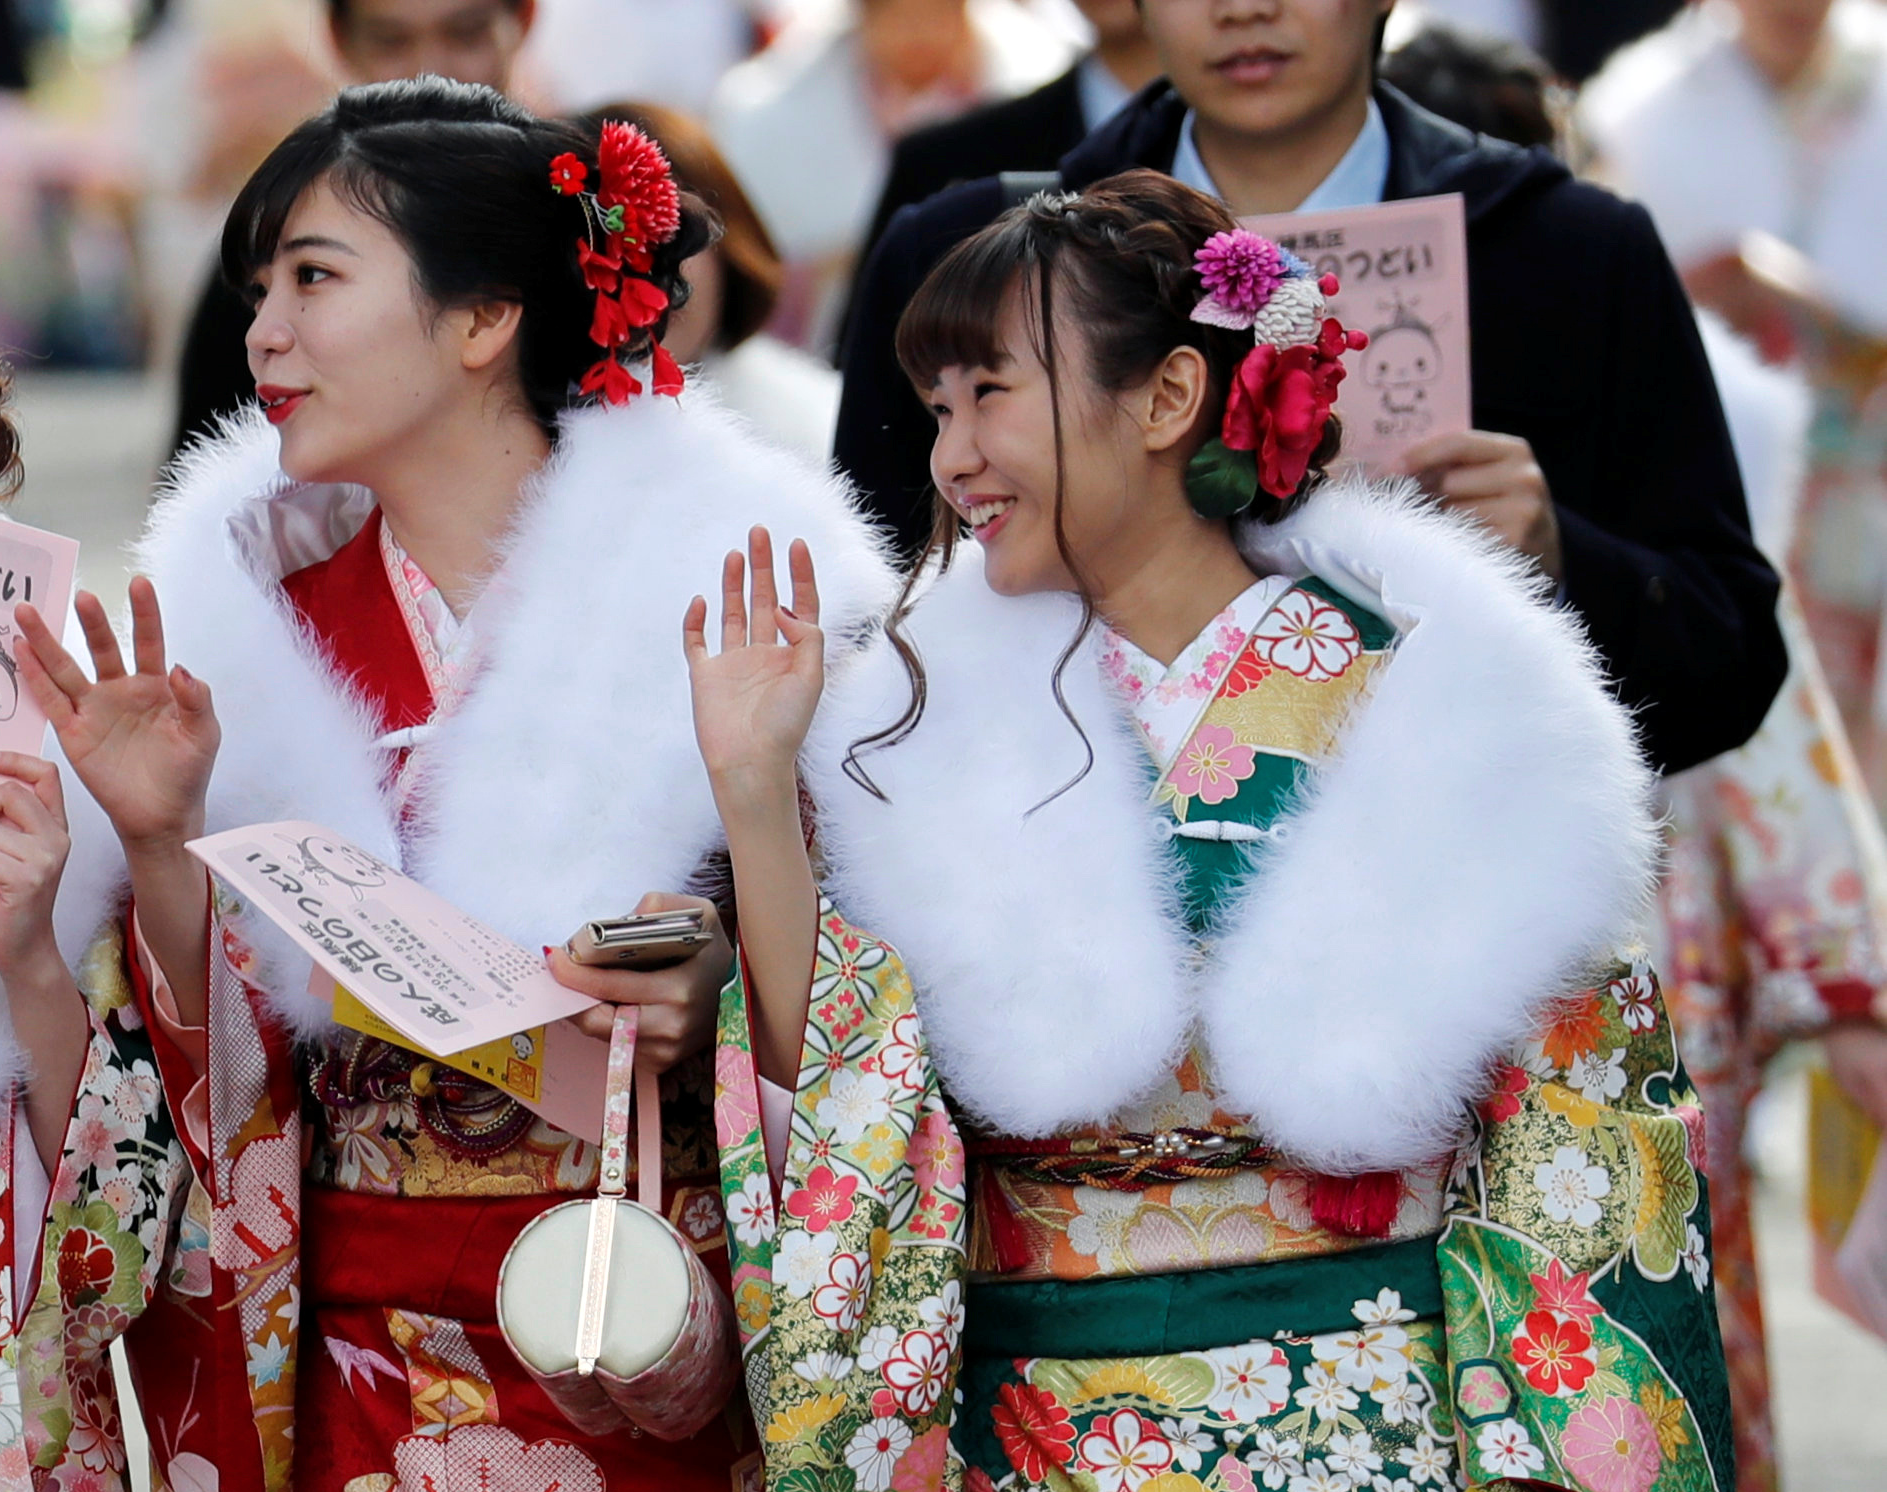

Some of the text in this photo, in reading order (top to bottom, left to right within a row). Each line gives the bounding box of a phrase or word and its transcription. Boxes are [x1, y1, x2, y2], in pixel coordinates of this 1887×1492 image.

[246, 853, 459, 1024] 成人の日のつどい
[299, 921, 364, 973] 練馬区
